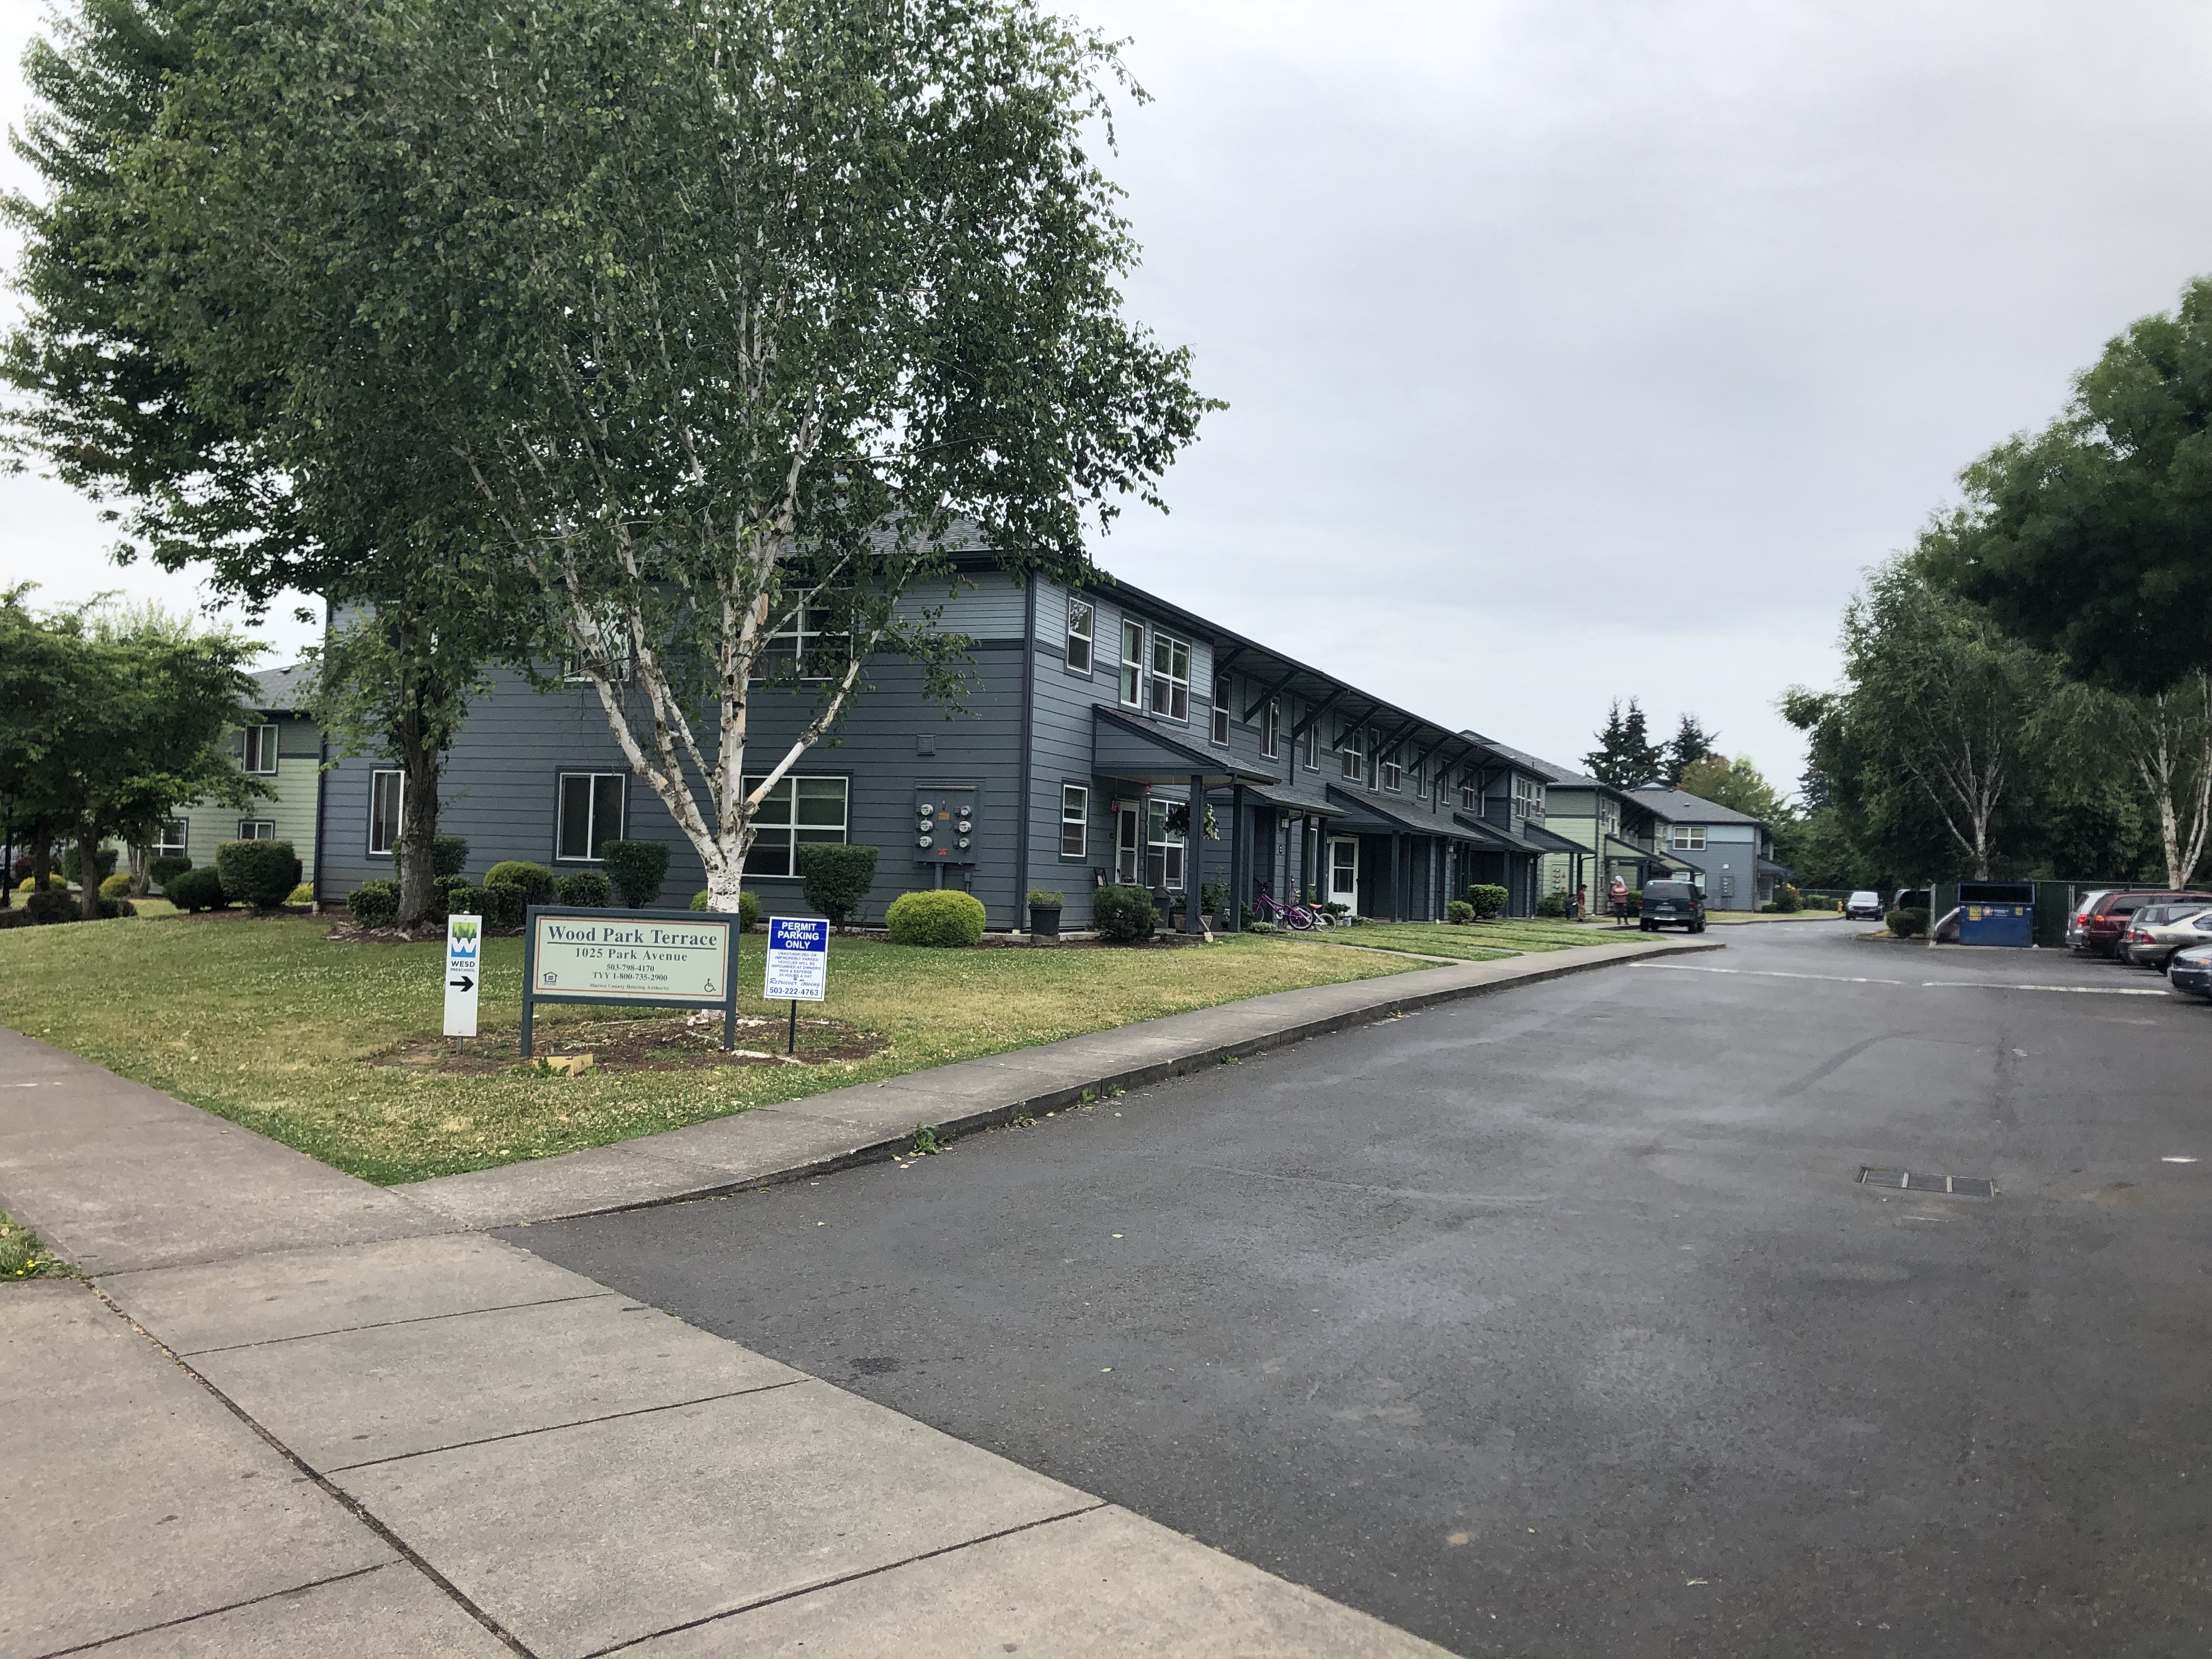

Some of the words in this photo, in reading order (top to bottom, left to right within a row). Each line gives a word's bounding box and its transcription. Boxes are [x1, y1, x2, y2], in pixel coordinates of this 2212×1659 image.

[782, 922, 817, 932] PERMIT
[548, 926, 596, 941] Wood
[603, 928, 644, 943] Park
[651, 929, 717, 946] Terrace
[777, 930, 819, 940] PARKING
[785, 940, 811, 949] ONLY
[575, 947, 603, 958] 1025
[608, 949, 637, 960] Park
[642, 950, 687, 961] Avenue
[606, 964, 654, 972] 503-798-4170
[613, 973, 668, 981] 1-800-735-2900
[799, 979, 820, 989] Towing
[769, 987, 819, 996] 503-222-4763
